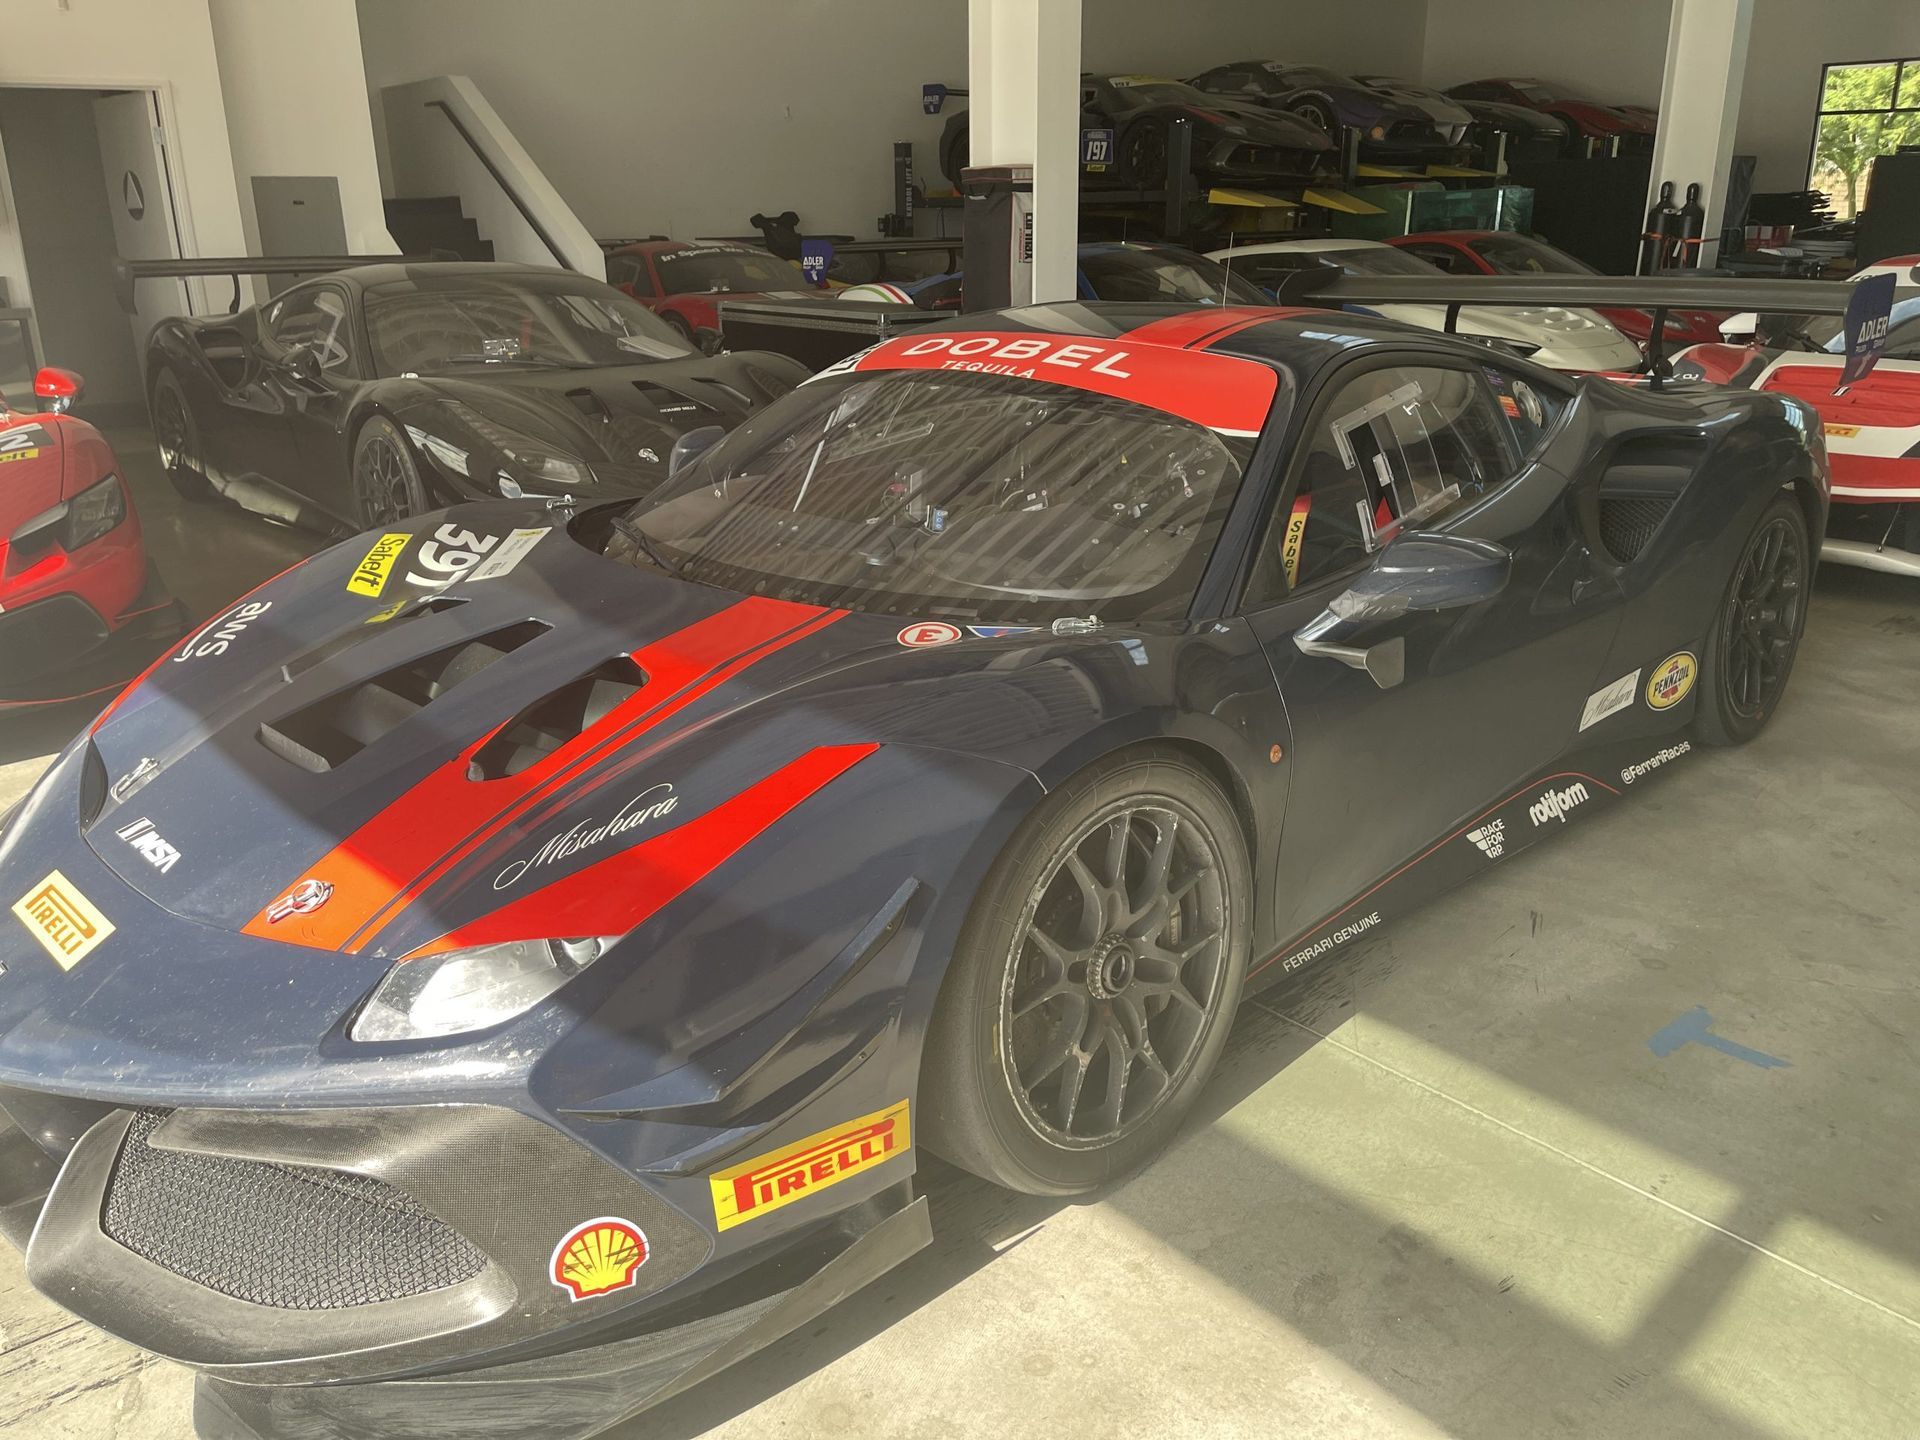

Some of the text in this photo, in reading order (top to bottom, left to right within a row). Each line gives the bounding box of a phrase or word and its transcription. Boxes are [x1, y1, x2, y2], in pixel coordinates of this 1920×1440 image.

[1086, 141, 1108, 161] 197
[803, 256, 824, 266] ADLER
[1857, 316, 1889, 344] ADLER
[901, 337, 1132, 379] DOBEL
[940, 359, 1037, 380] TEQUILA
[354, 538, 406, 588] Sabelt
[405, 523, 500, 594] 397
[196, 601, 273, 657] aws
[914, 628, 943, 643] E
[1653, 664, 1690, 698] PENNZOIL
[1620, 741, 1691, 784] @FerrariRaces
[1529, 782, 1590, 827] rotiform
[115, 816, 182, 874] IMSA
[493, 783, 679, 890] Misahara
[1481, 818, 1506, 838] RACE
[1486, 831, 1505, 848] FOR
[24, 883, 97, 955] PIRELLI
[1282, 911, 1382, 973] FERRARI GENUINE
[732, 1117, 896, 1214] PIRELLI
